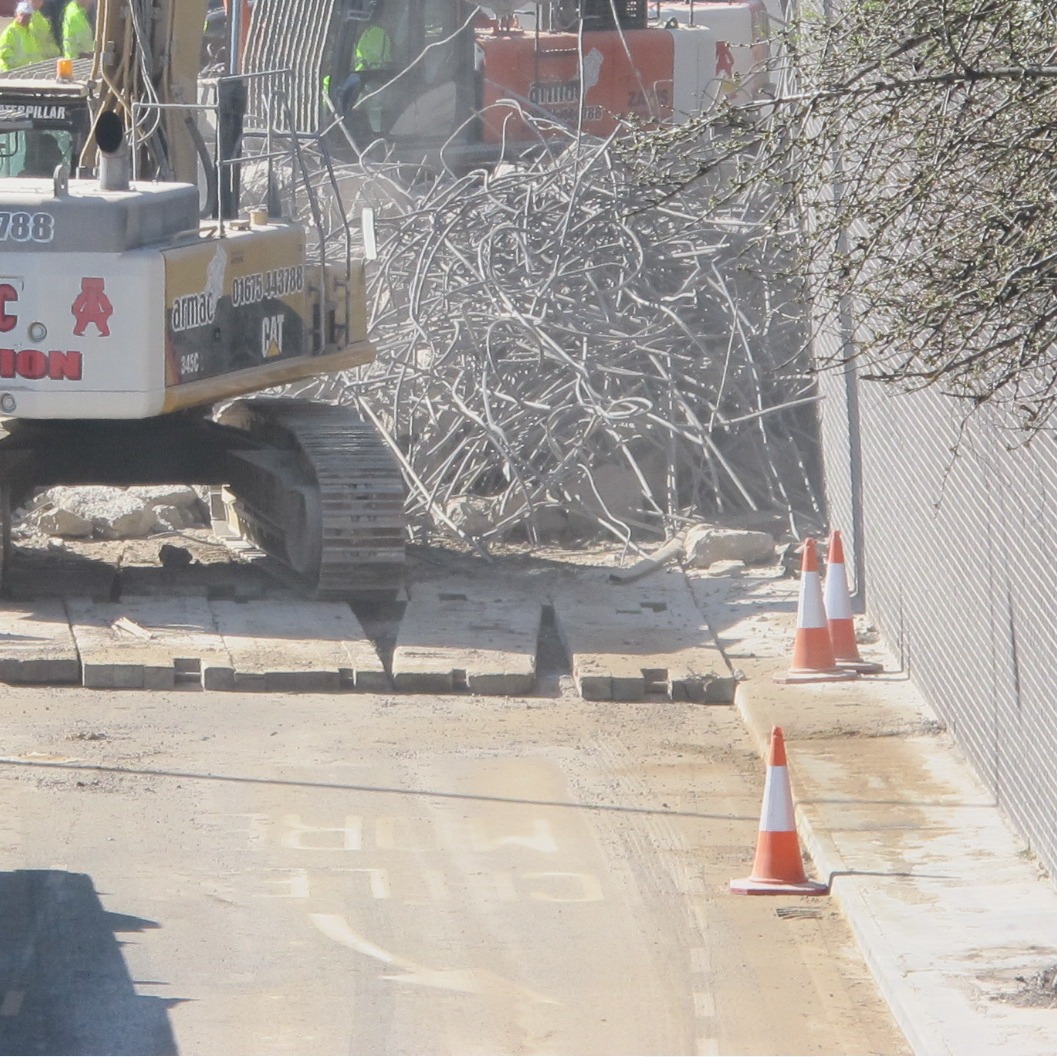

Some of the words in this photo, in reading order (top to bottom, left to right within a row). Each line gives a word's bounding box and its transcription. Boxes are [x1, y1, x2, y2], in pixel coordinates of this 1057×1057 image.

[231, 273, 263, 307] 01675
[264, 264, 305, 299] 443788
[172, 292, 216, 332] armac
[262, 314, 285, 358] CAT
[181, 352, 200, 375] 345C
